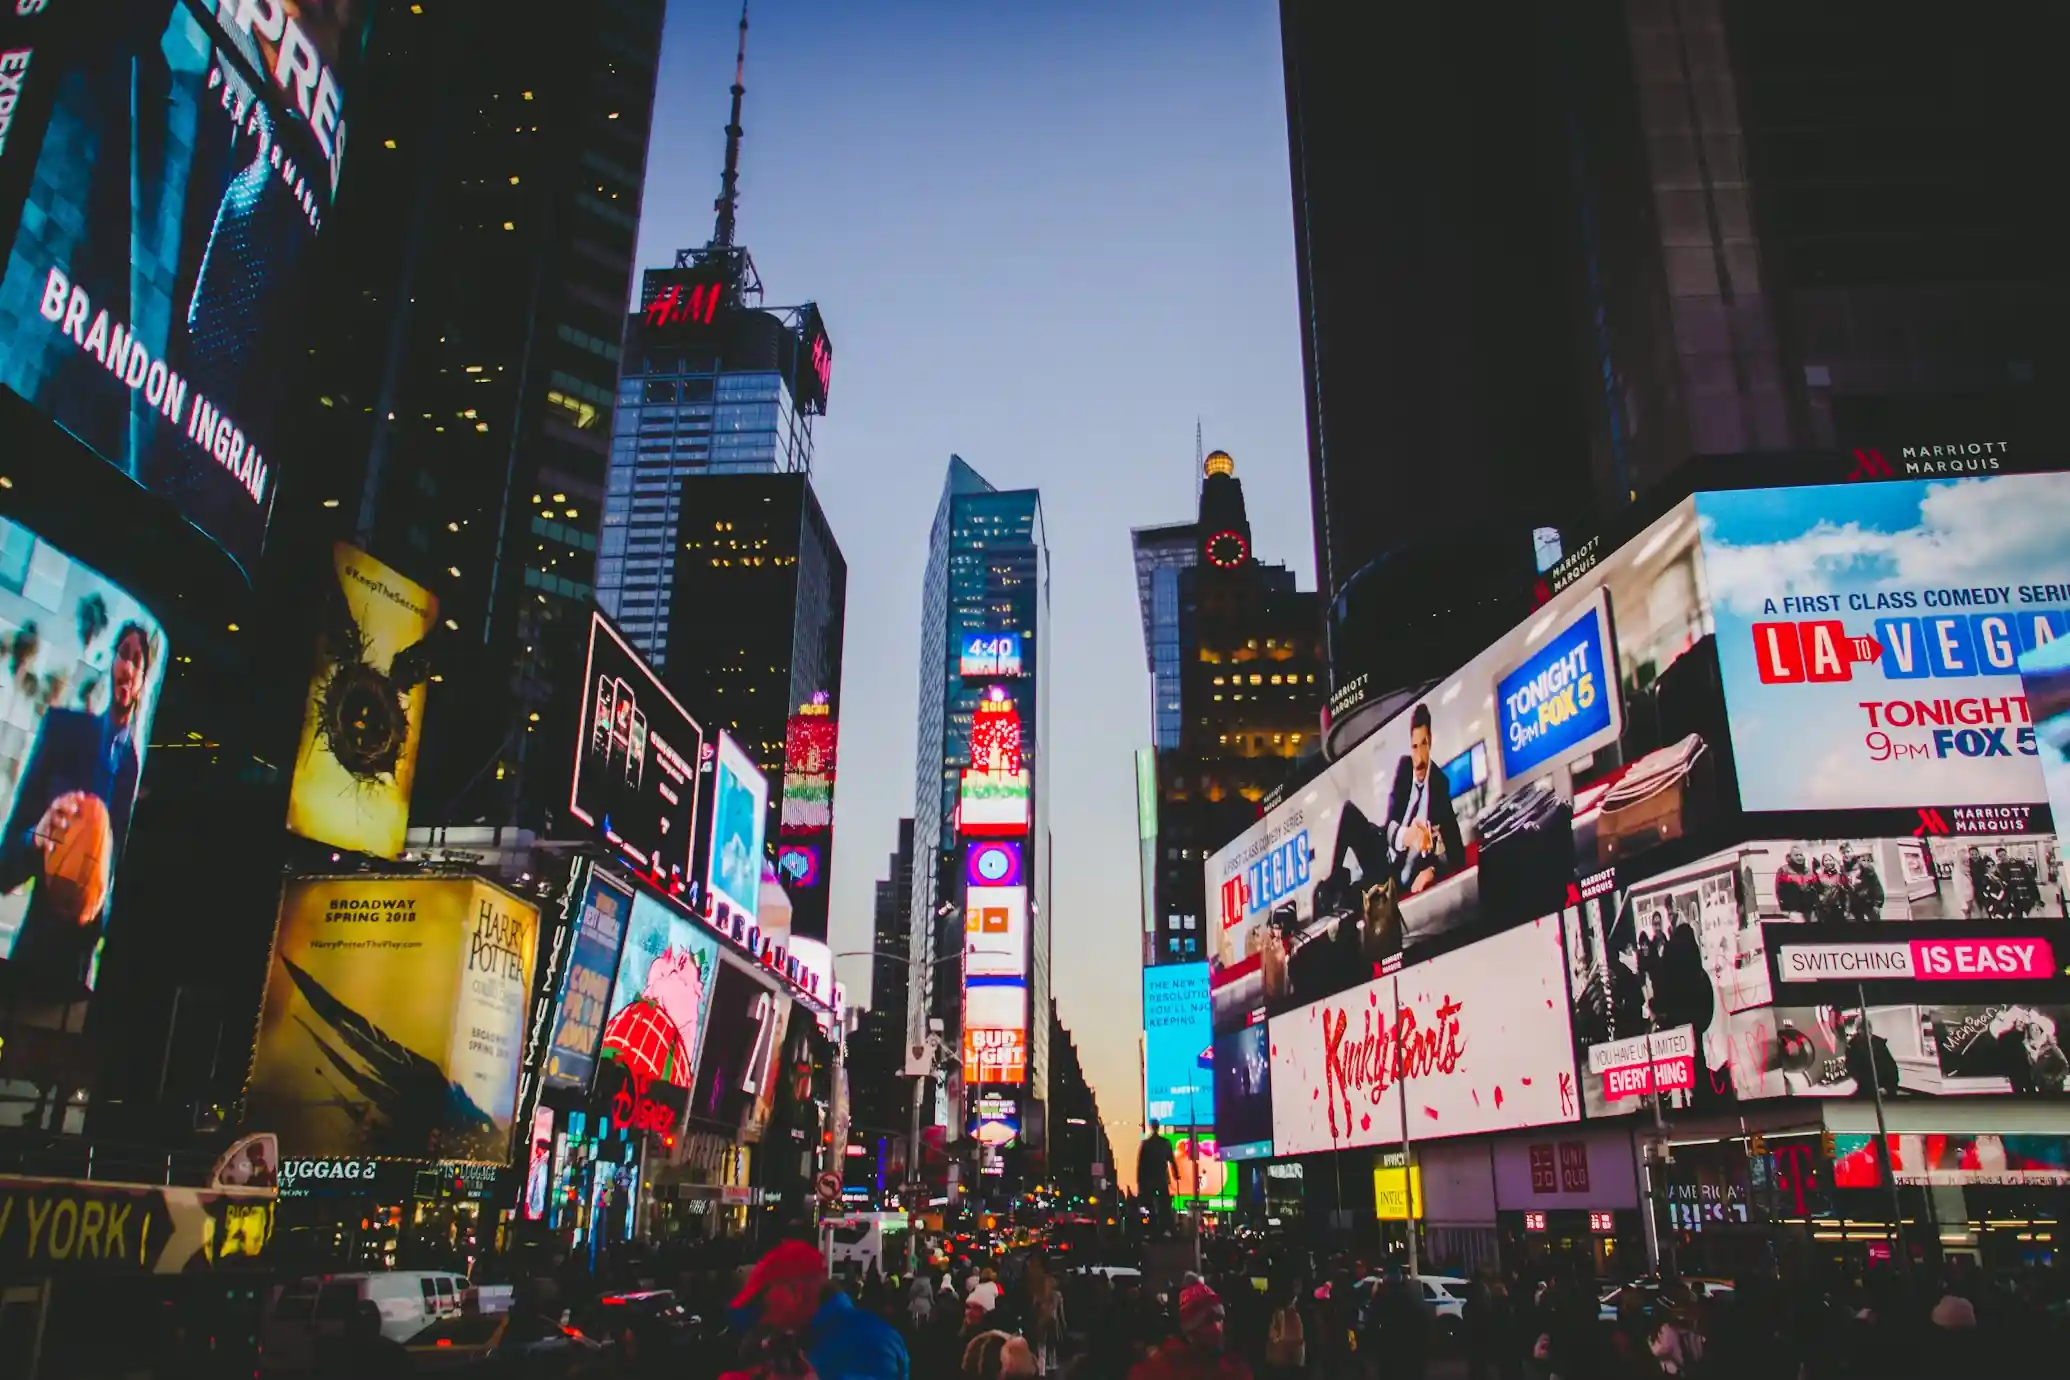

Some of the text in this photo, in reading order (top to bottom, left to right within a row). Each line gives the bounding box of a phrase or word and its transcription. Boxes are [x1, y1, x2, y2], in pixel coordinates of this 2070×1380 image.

[39, 267, 268, 505] BRANDON INGRAM
[1902, 441, 2009, 459] MARRIOTT
[1905, 457, 2000, 475] MARQUIS
[1552, 535, 1600, 579] MARRIOTT
[1553, 555, 1596, 592] MARQUIS
[1763, 598, 1778, 615] A
[1783, 594, 1841, 613] FIRST
[1849, 590, 1918, 611] CLASS
[1923, 586, 2011, 608] COMEDY
[968, 639, 1013, 657] 4:40
[1766, 625, 1842, 678] LA
[1852, 637, 1872, 661] TO
[1330, 673, 1369, 705] MARRIOTT
[1506, 640, 1589, 722] TONIGHT
[1331, 689, 1365, 718] MARQUIS
[1508, 672, 1595, 753] 9PM FOX 5
[1858, 696, 2033, 728] TONIGHT
[1865, 727, 2040, 761] 9PM FOX 5
[1953, 807, 2031, 821] MARRIOTT
[1955, 819, 2025, 832] MARQUIS
[1223, 834, 1308, 924] LA VEGAS
[1580, 867, 1616, 889] MARRIOTT
[1581, 879, 1613, 899] MARQUIS
[325, 911, 417, 923] SPRING 2018
[329, 899, 417, 910] BROADWAY
[478, 898, 530, 949] HARRY
[468, 930, 528, 988] POTTER
[1791, 944, 2036, 974] SWITCHING IS EASY
[1149, 980, 1168, 990] THE
[1172, 978, 1195, 989] NEW
[972, 1030, 1018, 1048] BUD
[1322, 994, 1468, 1139] Kinky Boots
[1594, 1049, 1612, 1066] YOU
[1614, 1044, 1637, 1062] HAVE
[1608, 1060, 1688, 1093] EVERYHING
[459, 1163, 497, 1182] LUGGAGE
[27, 1197, 133, 1260] YORK
